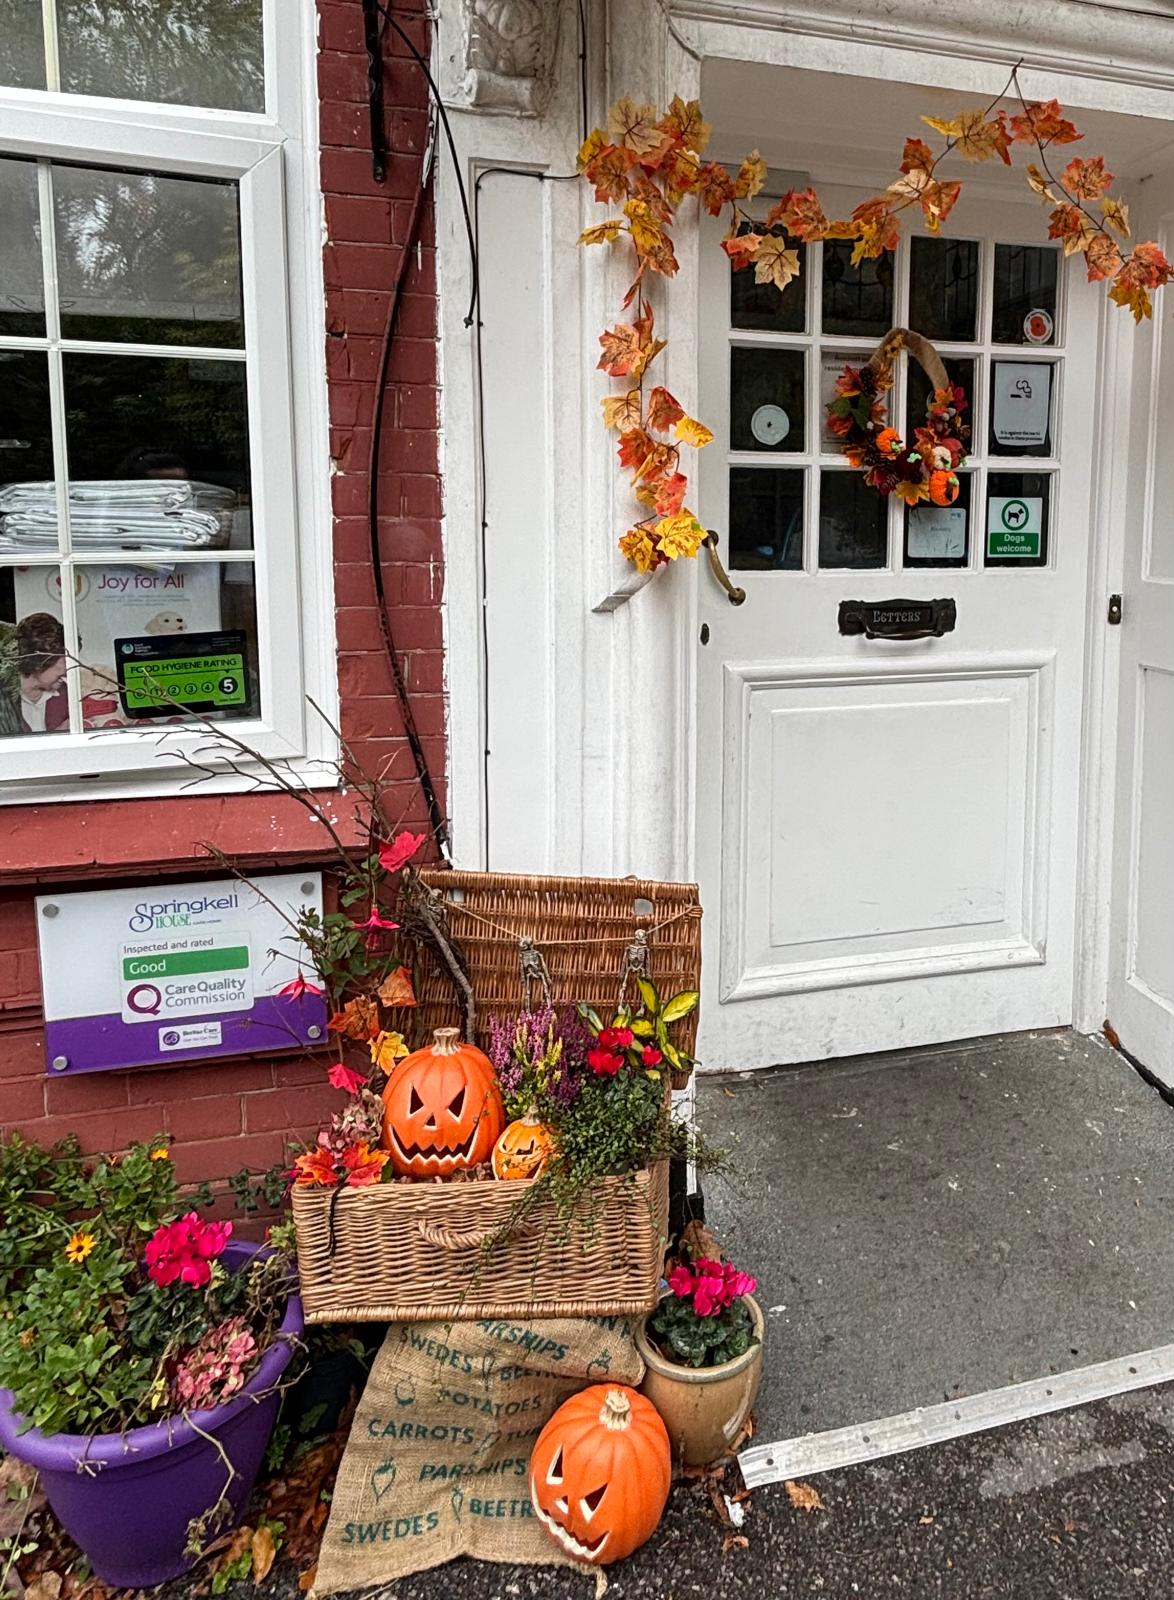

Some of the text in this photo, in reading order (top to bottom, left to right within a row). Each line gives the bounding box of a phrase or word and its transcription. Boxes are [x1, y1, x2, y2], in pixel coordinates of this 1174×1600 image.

[1003, 533, 1025, 543] Dogs
[996, 545, 1032, 553] welcome
[98, 574, 184, 592] Joy for All
[129, 658, 237, 675] FOOD HYGIENE RATING
[223, 679, 234, 692] 5
[129, 894, 239, 933] Springkell
[155, 913, 192, 929] HOUSE
[123, 937, 214, 955] Inspected and rated
[129, 960, 166, 975] Good
[165, 991, 246, 1008] Commission
[476, 1319, 569, 1360] ARSNIPS
[400, 1326, 474, 1373] SWEDES
[367, 1418, 475, 1444] CARROTS
[418, 1458, 528, 1482] PARSNIPS
[340, 1498, 533, 1543] SWEDES BEETR
